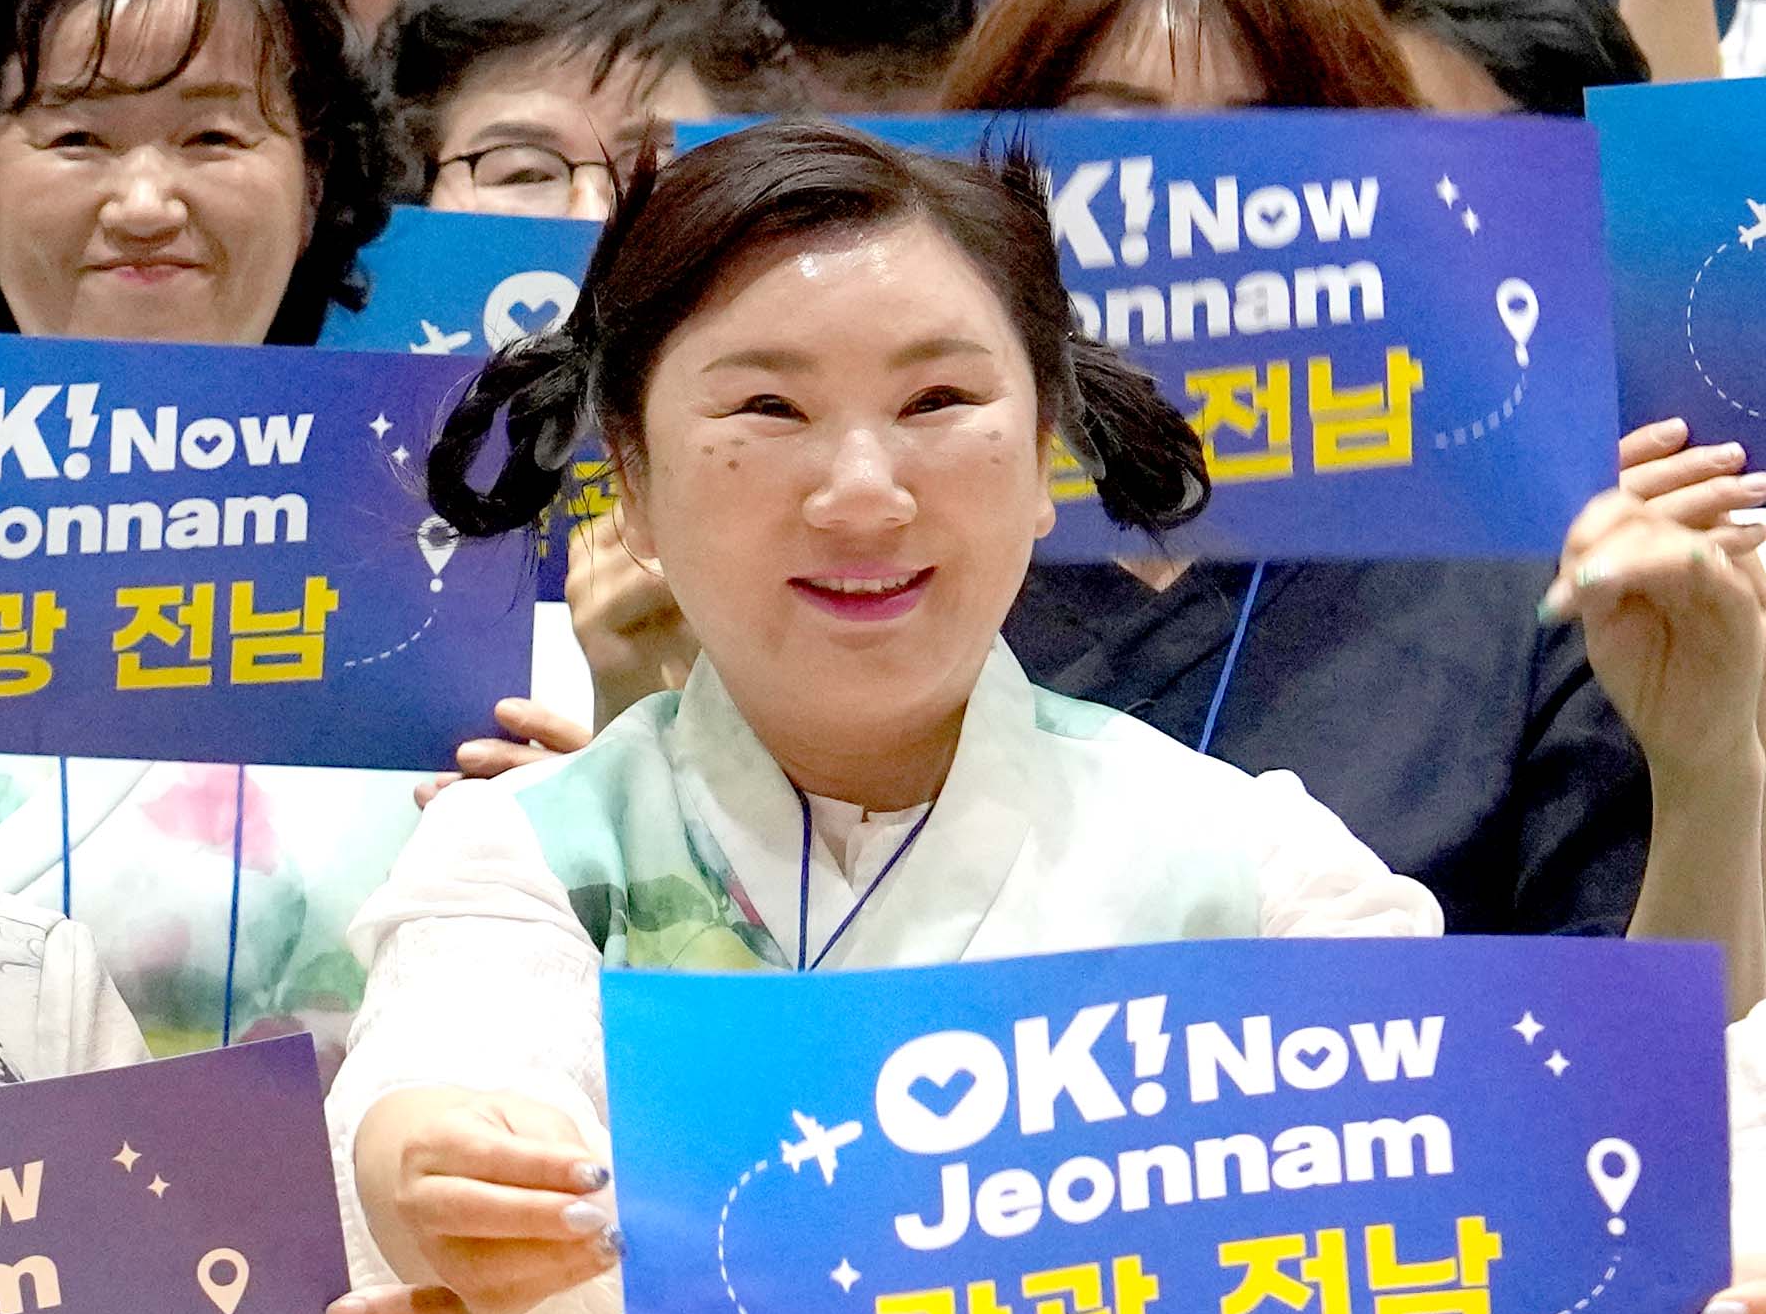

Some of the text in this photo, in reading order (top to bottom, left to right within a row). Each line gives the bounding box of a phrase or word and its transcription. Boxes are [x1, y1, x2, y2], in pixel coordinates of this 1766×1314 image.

[1046, 155, 1381, 270] K! Now
[108, 405, 315, 474] Now
[1183, 345, 1426, 488] 전남
[112, 577, 340, 692] 전남
[874, 994, 1447, 1155] OK! Now
[893, 1113, 1456, 1251] Jeonnam
